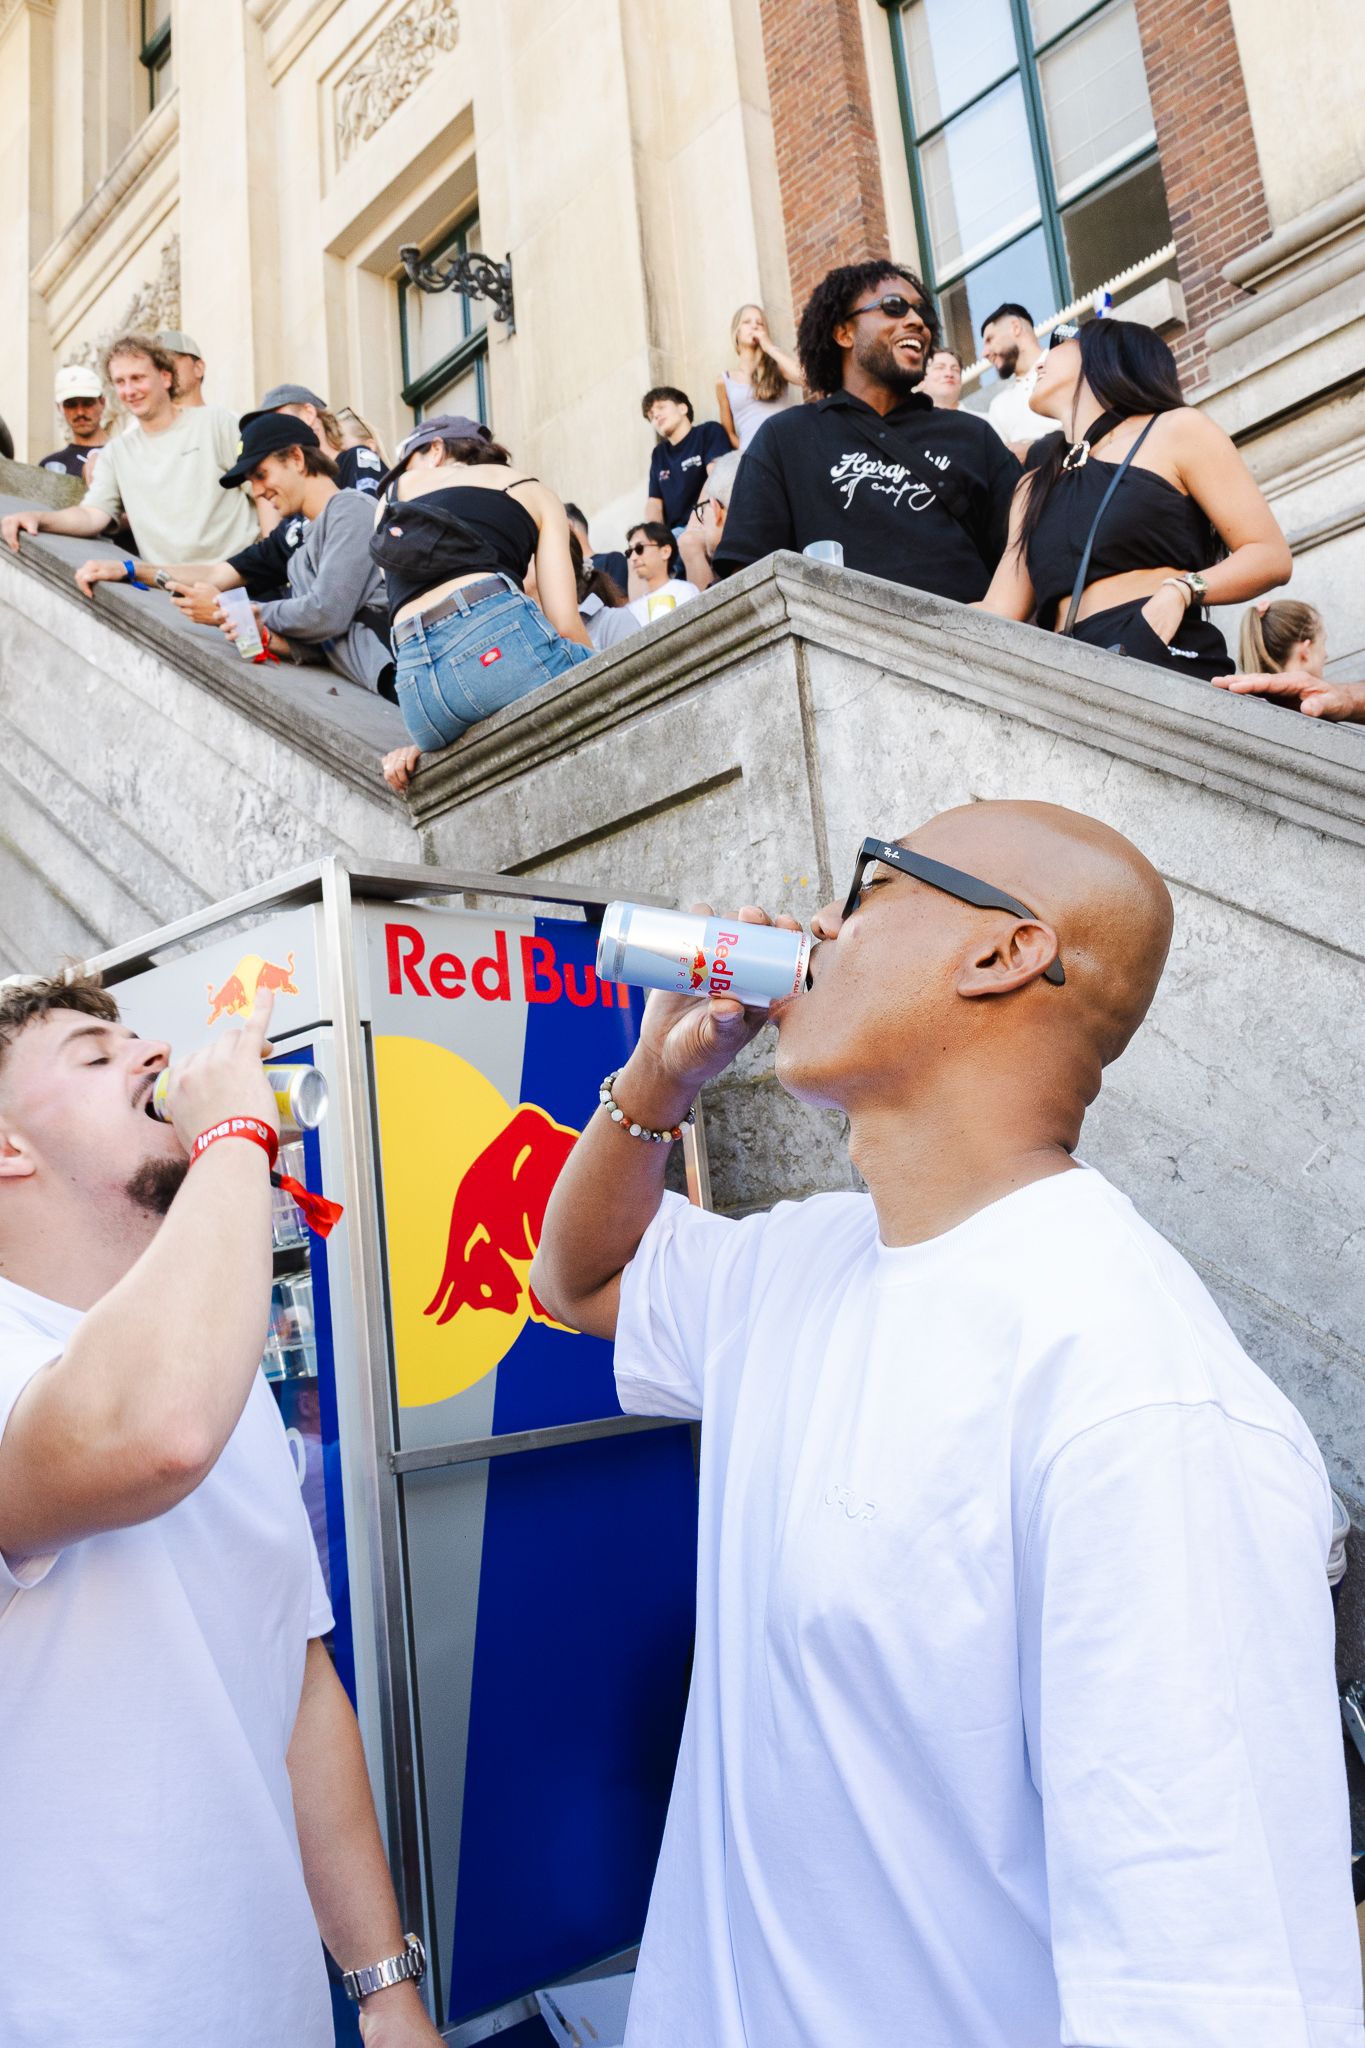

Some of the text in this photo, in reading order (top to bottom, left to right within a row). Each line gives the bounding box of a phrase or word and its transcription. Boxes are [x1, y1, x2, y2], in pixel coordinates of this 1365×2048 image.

[385, 923, 511, 1002] Red
[708, 931, 739, 999] Red Bu
[197, 1119, 268, 1150] Red Bull
